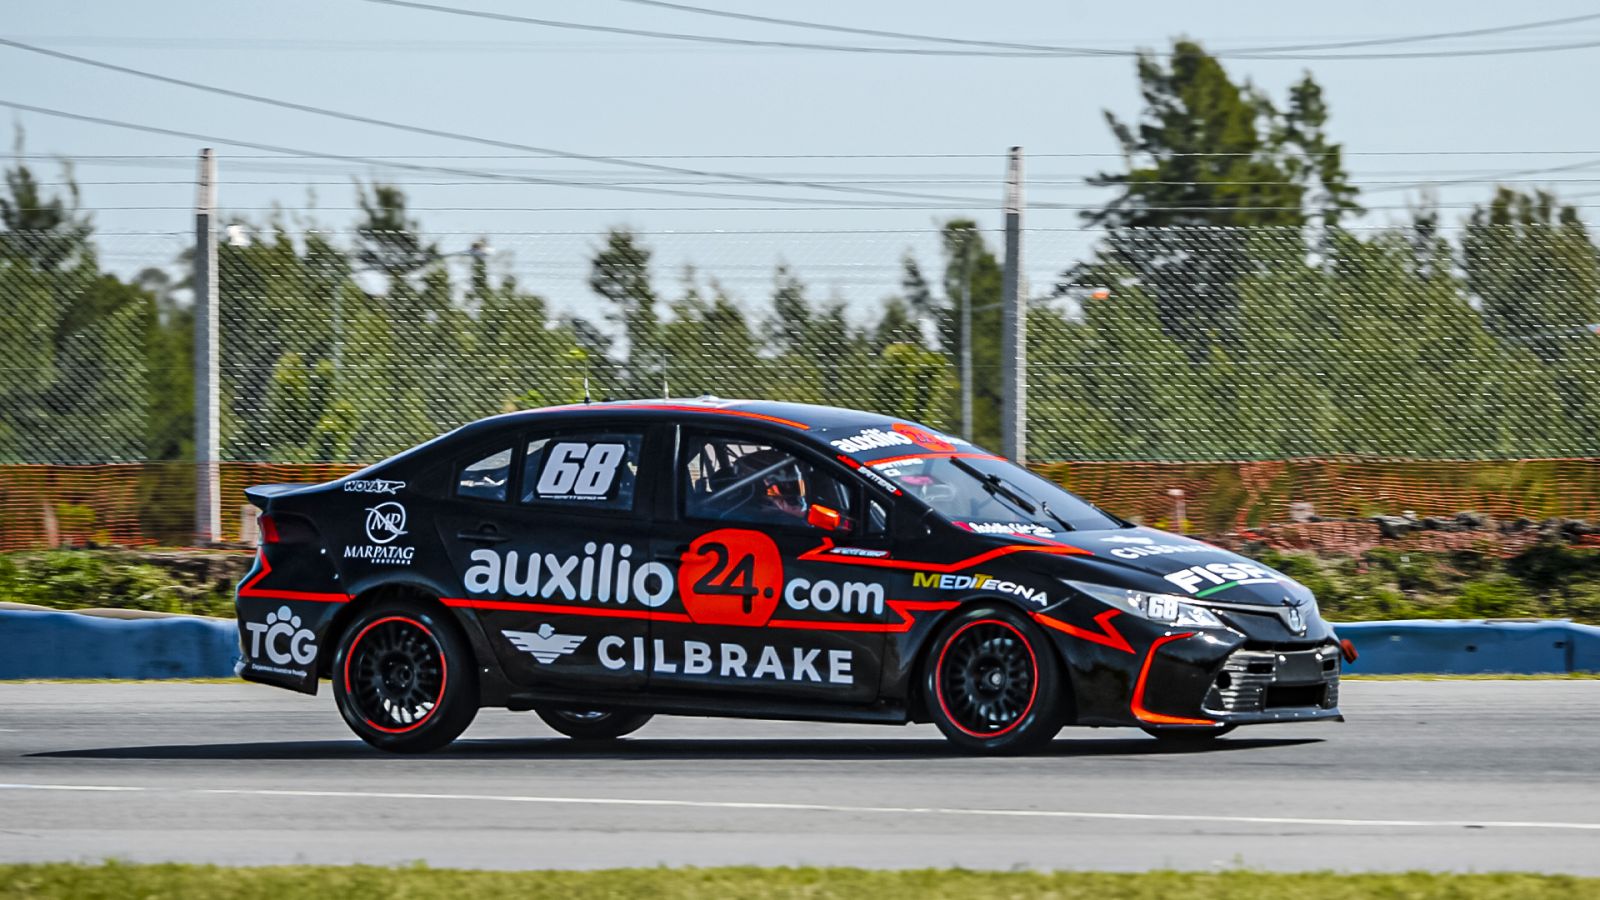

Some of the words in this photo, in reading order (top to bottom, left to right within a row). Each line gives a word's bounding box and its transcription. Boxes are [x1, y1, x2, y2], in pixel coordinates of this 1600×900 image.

[536, 443, 625, 495] 68
[343, 545, 415, 559] MARPATAG
[913, 572, 1048, 607] MEDITECNA
[1148, 597, 1178, 620] 68
[246, 622, 318, 665] TCG
[597, 635, 854, 684] CILBRAKE
